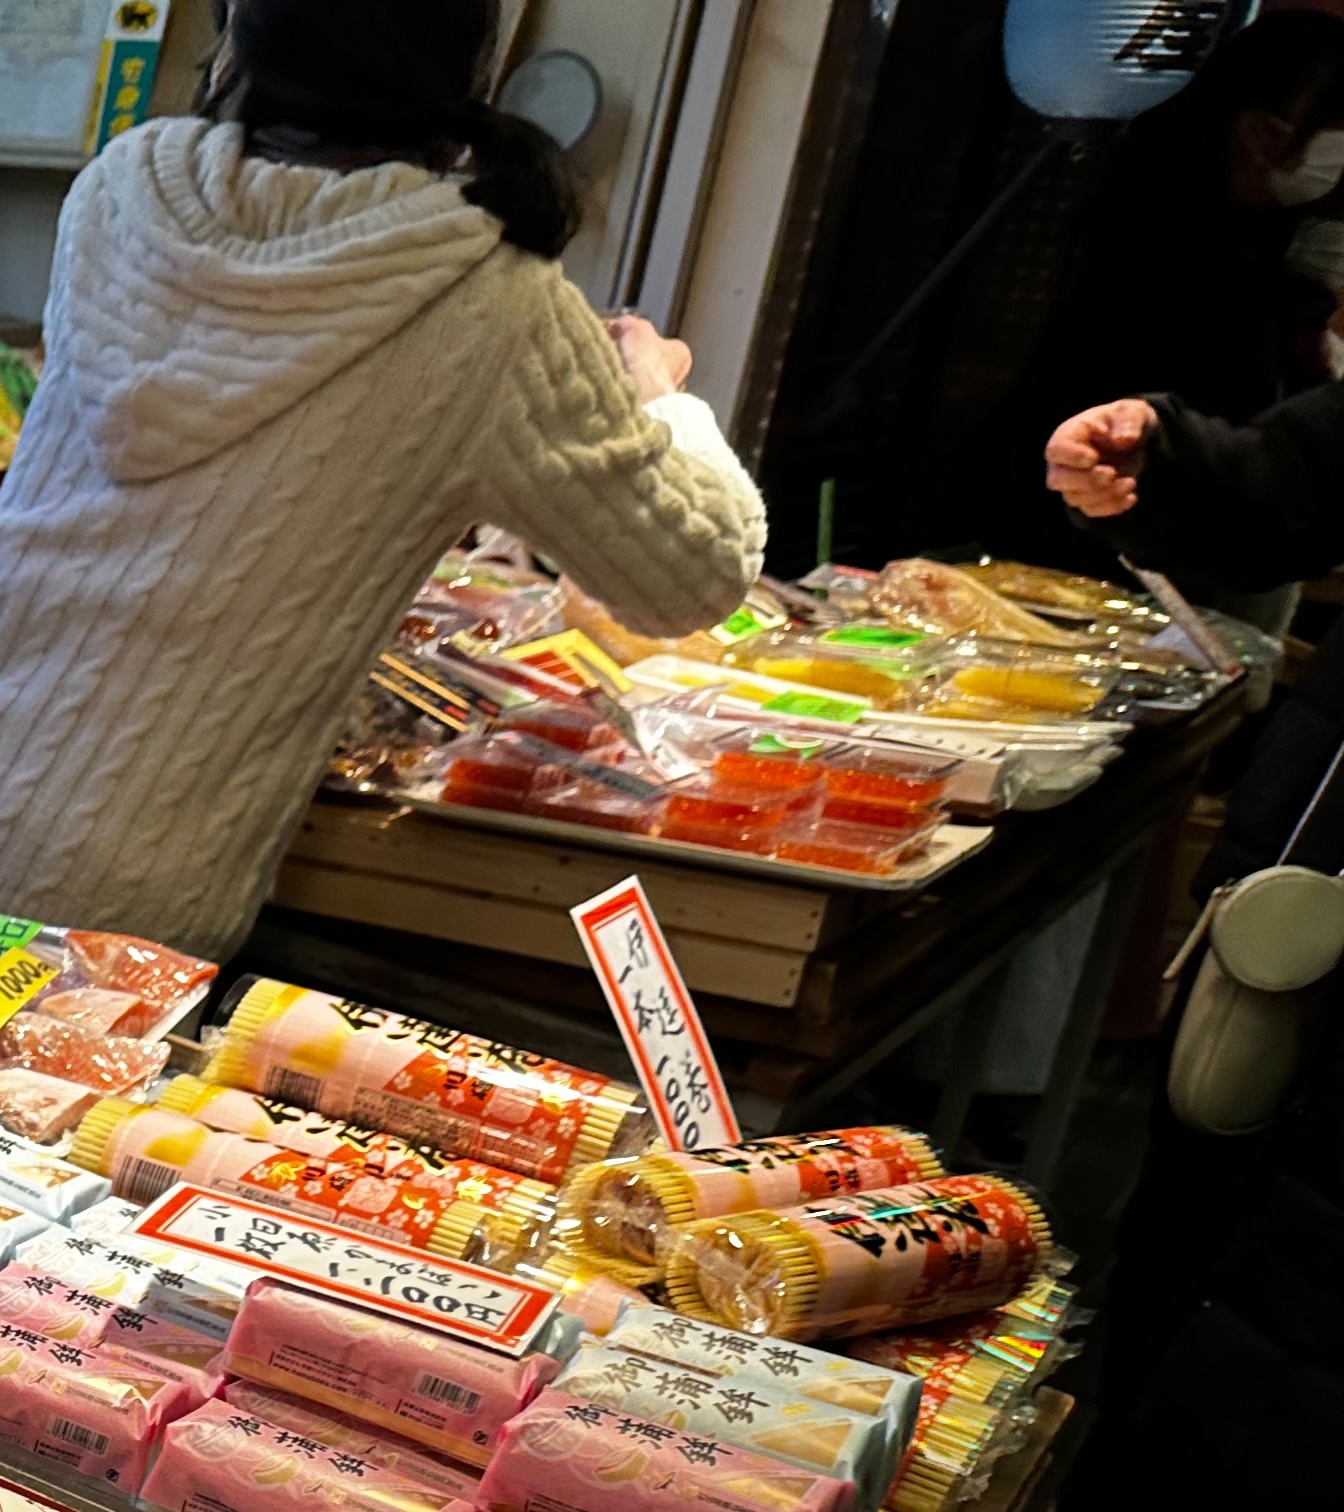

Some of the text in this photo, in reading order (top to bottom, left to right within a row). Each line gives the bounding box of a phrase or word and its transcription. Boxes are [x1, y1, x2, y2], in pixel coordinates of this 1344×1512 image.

[22, 1274, 159, 1333] 御蒲鉾
[651, 1319, 814, 1379] 御蒲鉾
[604, 1356, 770, 1425] 御蒲鉾
[228, 1413, 380, 1478] 御蒲鉾
[564, 1401, 736, 1468] 御蒲鉾
